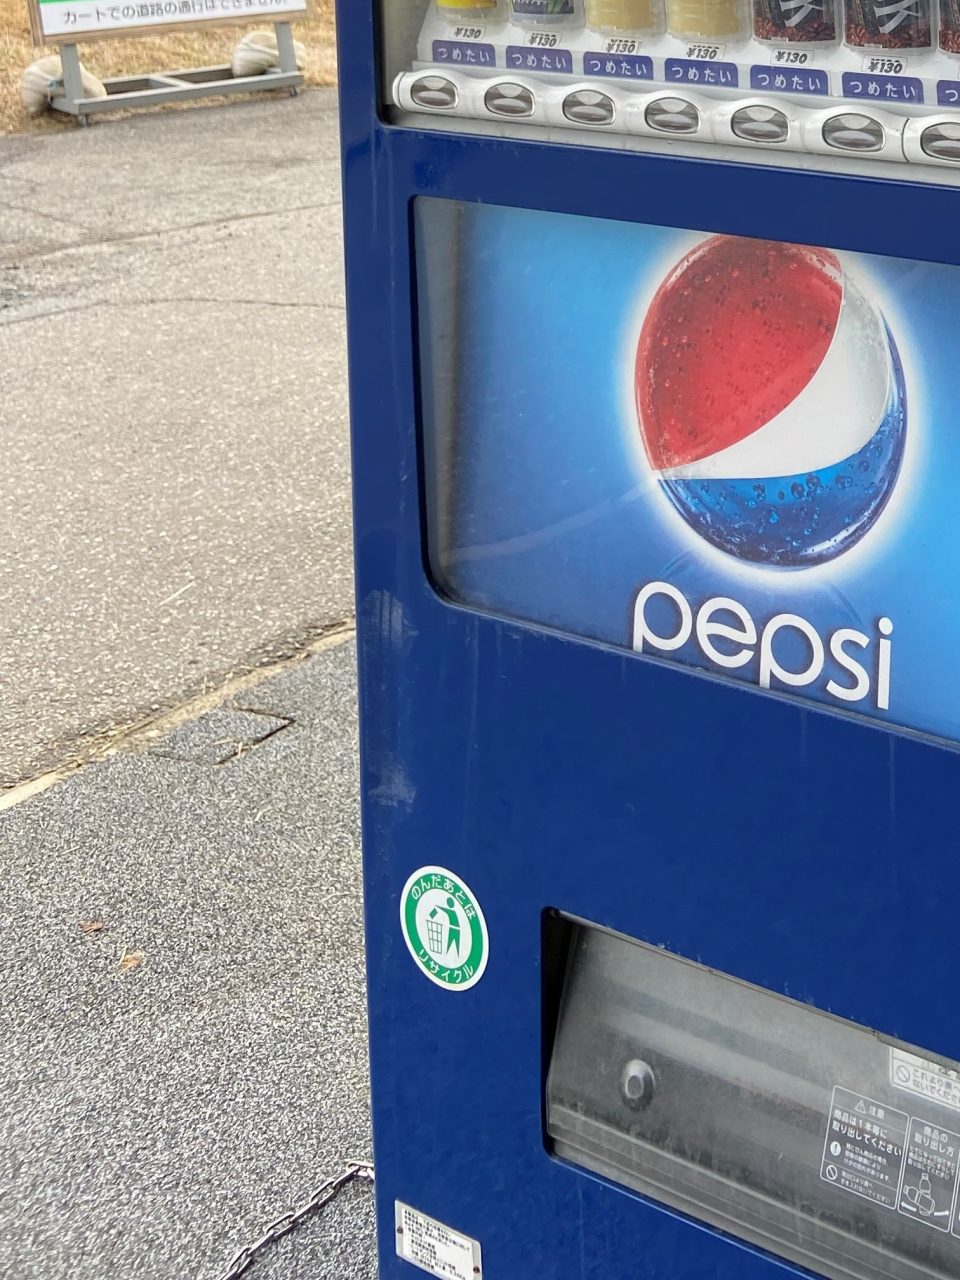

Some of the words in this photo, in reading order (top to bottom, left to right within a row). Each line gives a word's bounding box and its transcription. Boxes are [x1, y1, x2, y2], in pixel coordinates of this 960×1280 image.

[454, 27, 481, 38] ¥130
[528, 35, 556, 47] ¥130
[605, 41, 635, 54] ¥130
[437, 47, 489, 63] つめたい
[511, 53, 566, 69] つめたい
[686, 47, 717, 59] ¥130
[775, 51, 808, 64] ¥130
[589, 59, 647, 76] つめたい
[671, 65, 731, 83] つめたい
[868, 61, 902, 74] ¥130
[757, 73, 821, 91] つめたい
[850, 81, 916, 97] つめたい
[632, 581, 894, 711] pepsi
[411, 875, 476, 920] のんだあとは
[418, 949, 474, 984] リサイクル
[914, 1132, 955, 1157] 取り出し方
